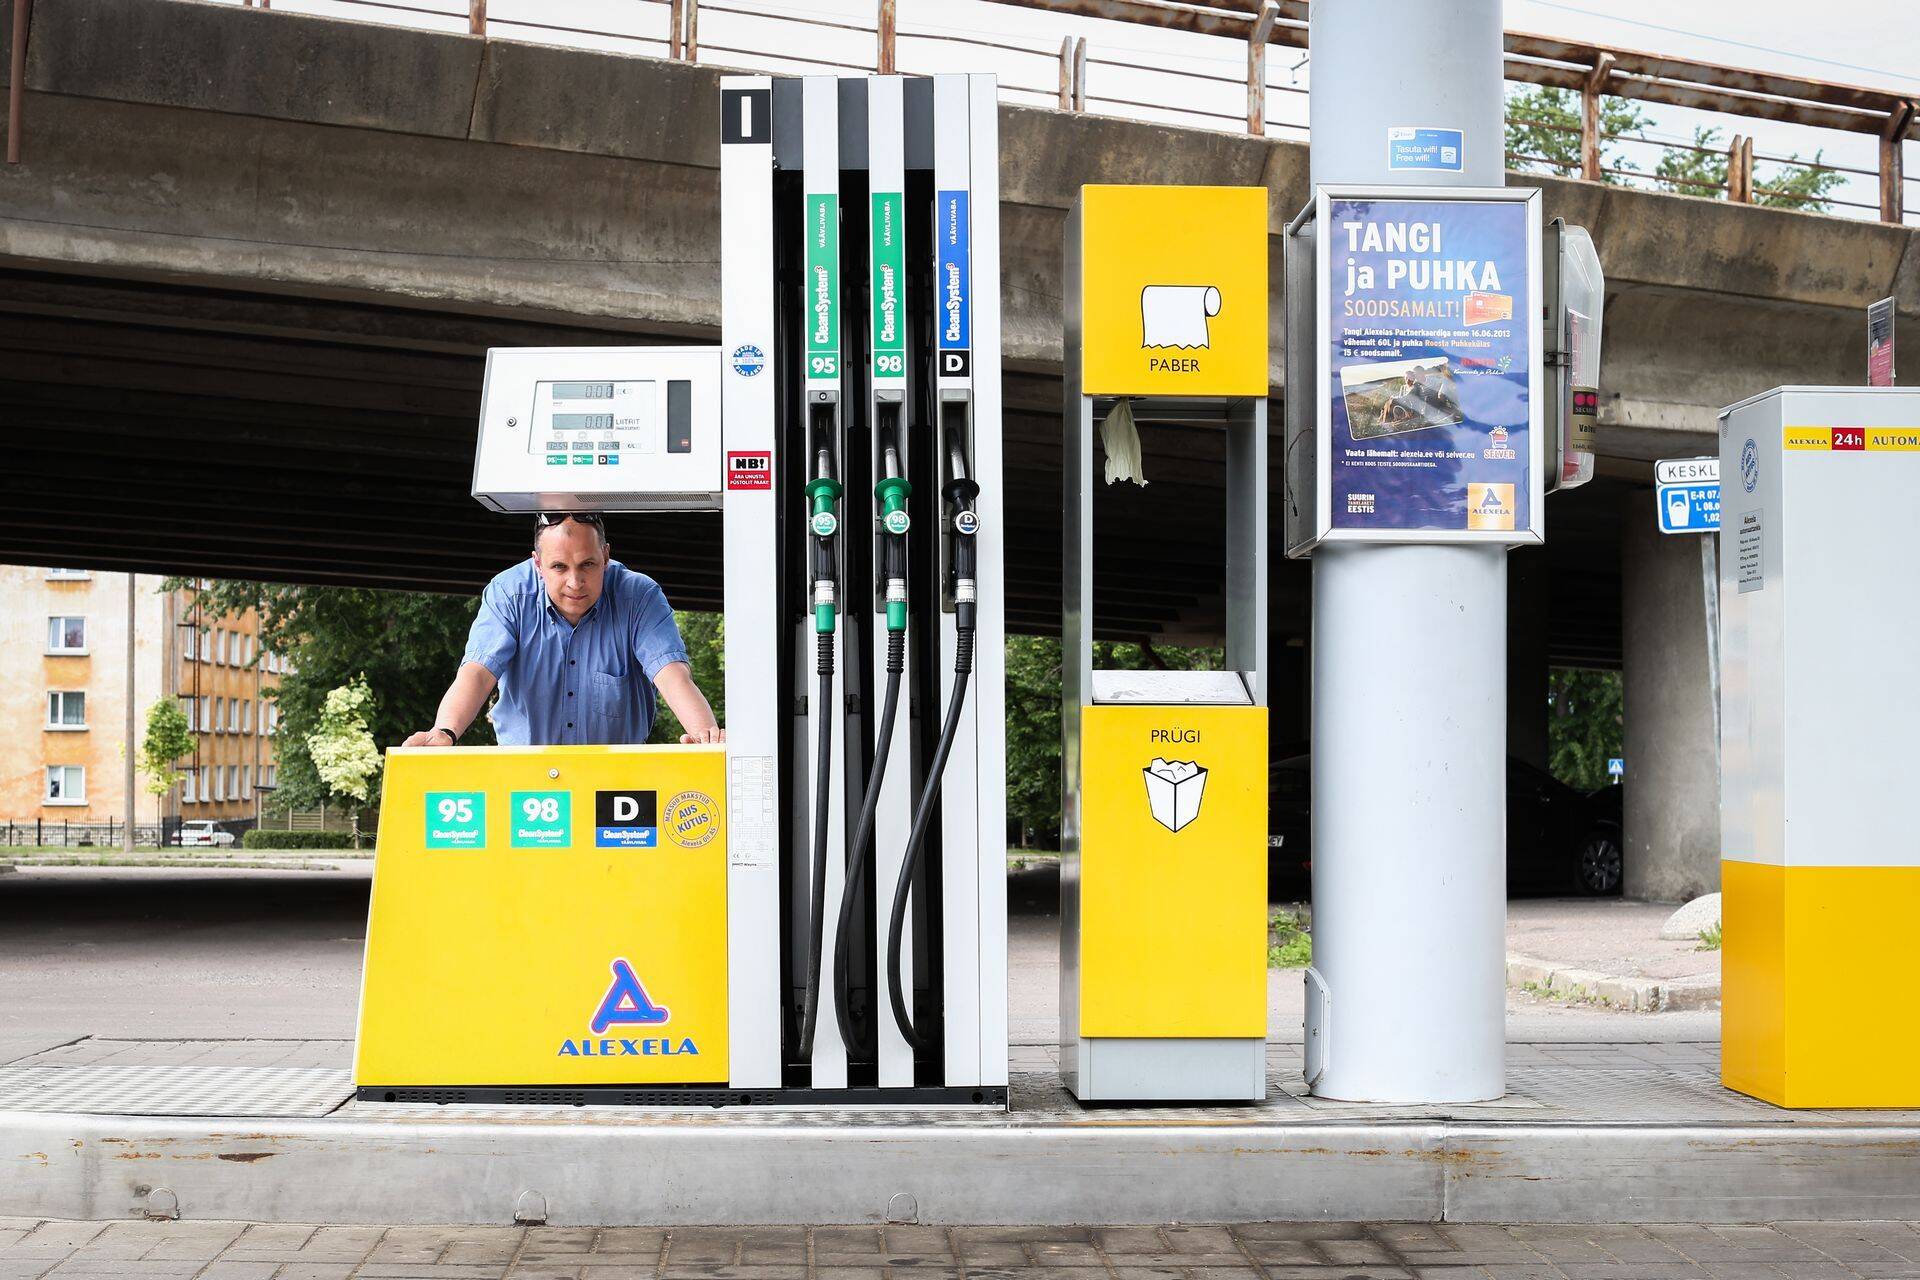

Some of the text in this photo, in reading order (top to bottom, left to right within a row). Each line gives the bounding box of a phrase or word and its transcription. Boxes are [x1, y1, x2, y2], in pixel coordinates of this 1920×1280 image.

[1396, 145, 1438, 154] Tasuta wifi!
[1396, 154, 1430, 162] Free wifi!
[1343, 222, 1441, 252] TANGI
[1344, 258, 1501, 296] ja PUHKA
[1344, 300, 1460, 318] SOODSAMALT!
[1343, 328, 1362, 337] Tangi
[1364, 328, 1393, 336] Alexelas
[1395, 329, 1451, 338] Partnerkaardiga
[1471, 330, 1511, 338] 16.06.2013
[1343, 338, 1376, 346] vähemalt
[1393, 339, 1400, 348] ja
[1402, 339, 1423, 347] puhka
[1353, 349, 1359, 357] €
[1361, 349, 1403, 357] soodsamalt.
[811, 357, 836, 374] 95
[877, 355, 903, 373] 98
[946, 354, 964, 372] D
[1150, 358, 1200, 372] PABER
[1834, 434, 1862, 445] 24h
[1872, 436, 1920, 445] AUTOM
[1345, 449, 1475, 459] Vaata lähemalt: alexela.ee või selver.eu
[1483, 449, 1516, 460] SELVER
[736, 458, 764, 469] NB!
[1668, 465, 1716, 478] KESKL
[1347, 493, 1375, 501] SUURIM
[1691, 490, 1720, 500] E-R 07.
[1347, 505, 1375, 513] EESTIS
[1696, 502, 1720, 511] L 08.0
[817, 518, 831, 526] 95
[892, 516, 905, 525] 98
[965, 514, 973, 523] D
[1151, 726, 1200, 743] PRÜGI
[438, 799, 473, 823] 95
[523, 797, 559, 823] 98
[613, 796, 639, 821] D
[665, 793, 710, 822] MAKSUD MAKSTUD
[678, 805, 698, 819] AUS
[677, 813, 709, 833] KÜTUS
[681, 839, 702, 847] Alexela
[710, 828, 717, 836] AS
[557, 1037, 699, 1056] ALEXELA
